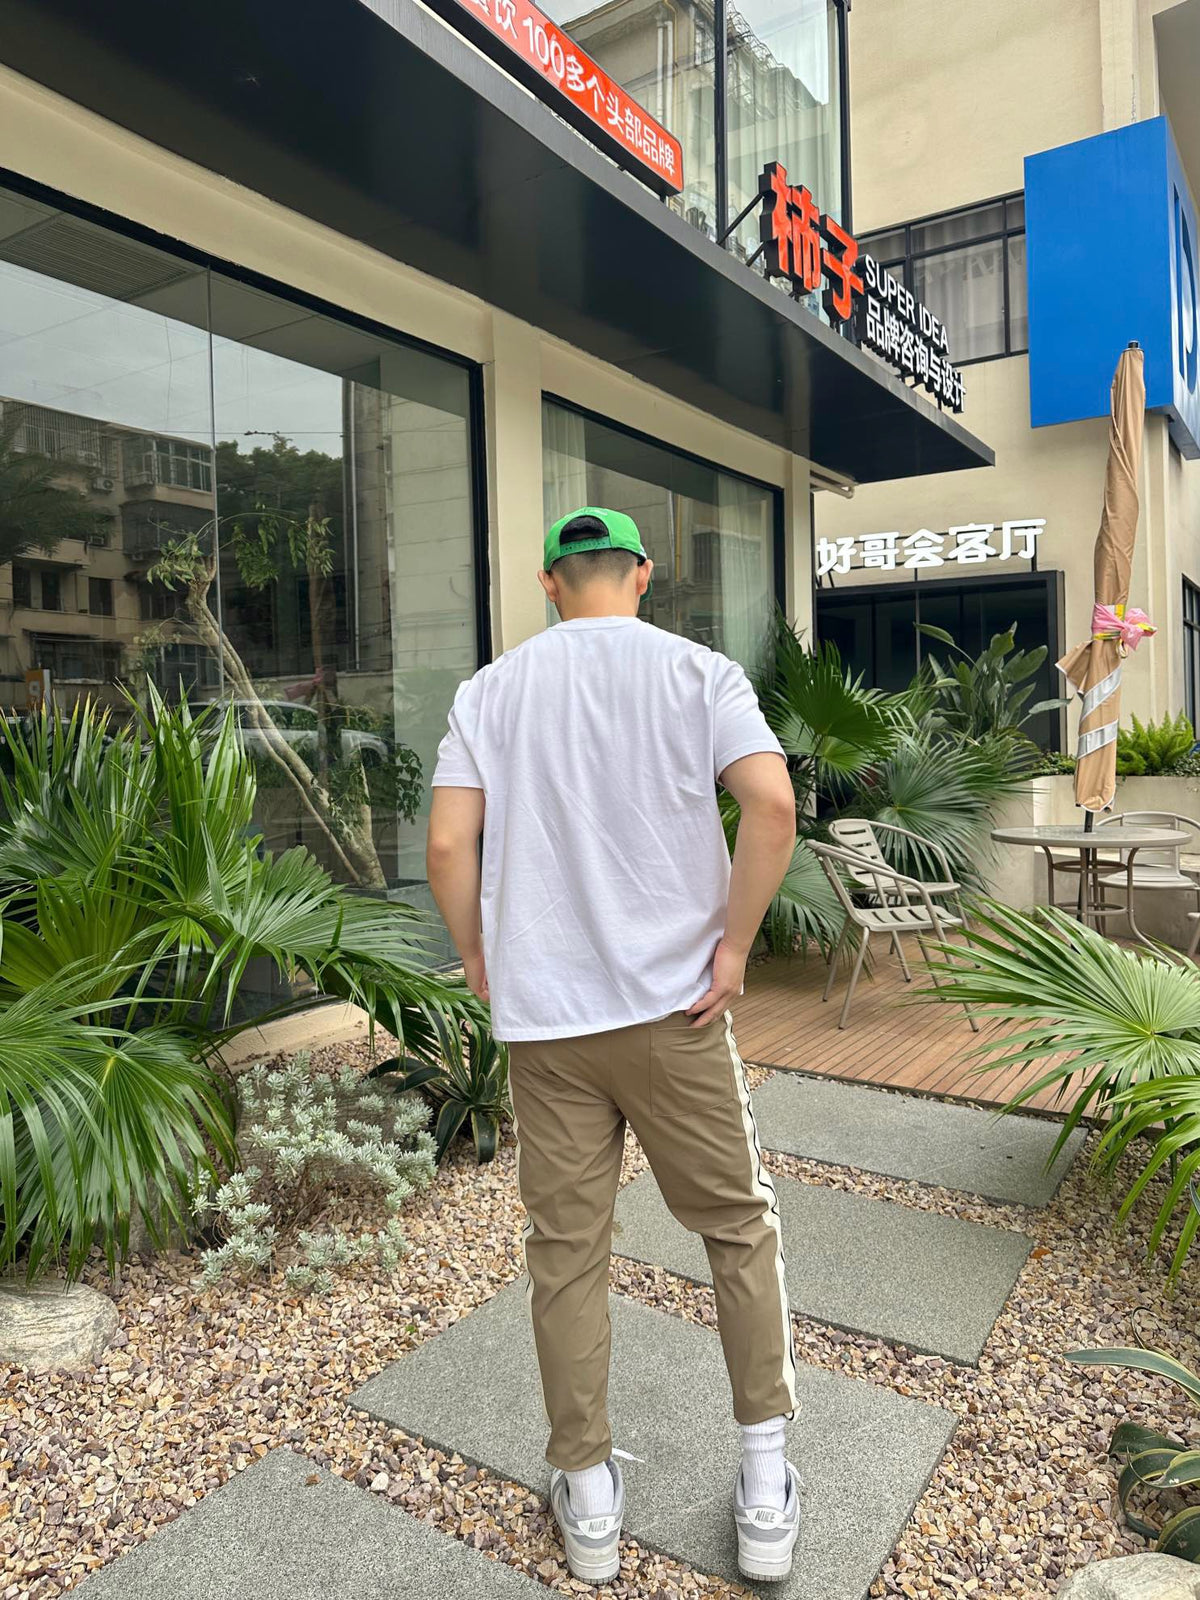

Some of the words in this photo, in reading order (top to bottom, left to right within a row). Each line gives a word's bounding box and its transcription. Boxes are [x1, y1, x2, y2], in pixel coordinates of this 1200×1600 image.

[522, 16, 676, 176] 100多个头部品牌
[770, 163, 865, 320] 柿子
[865, 254, 916, 324] SUPER
[918, 302, 950, 355] IDEA
[866, 294, 967, 412] 品牌咨询与设计
[816, 518, 1047, 576] 好哥会客厅
[755, 1510, 776, 1524] NIKE
